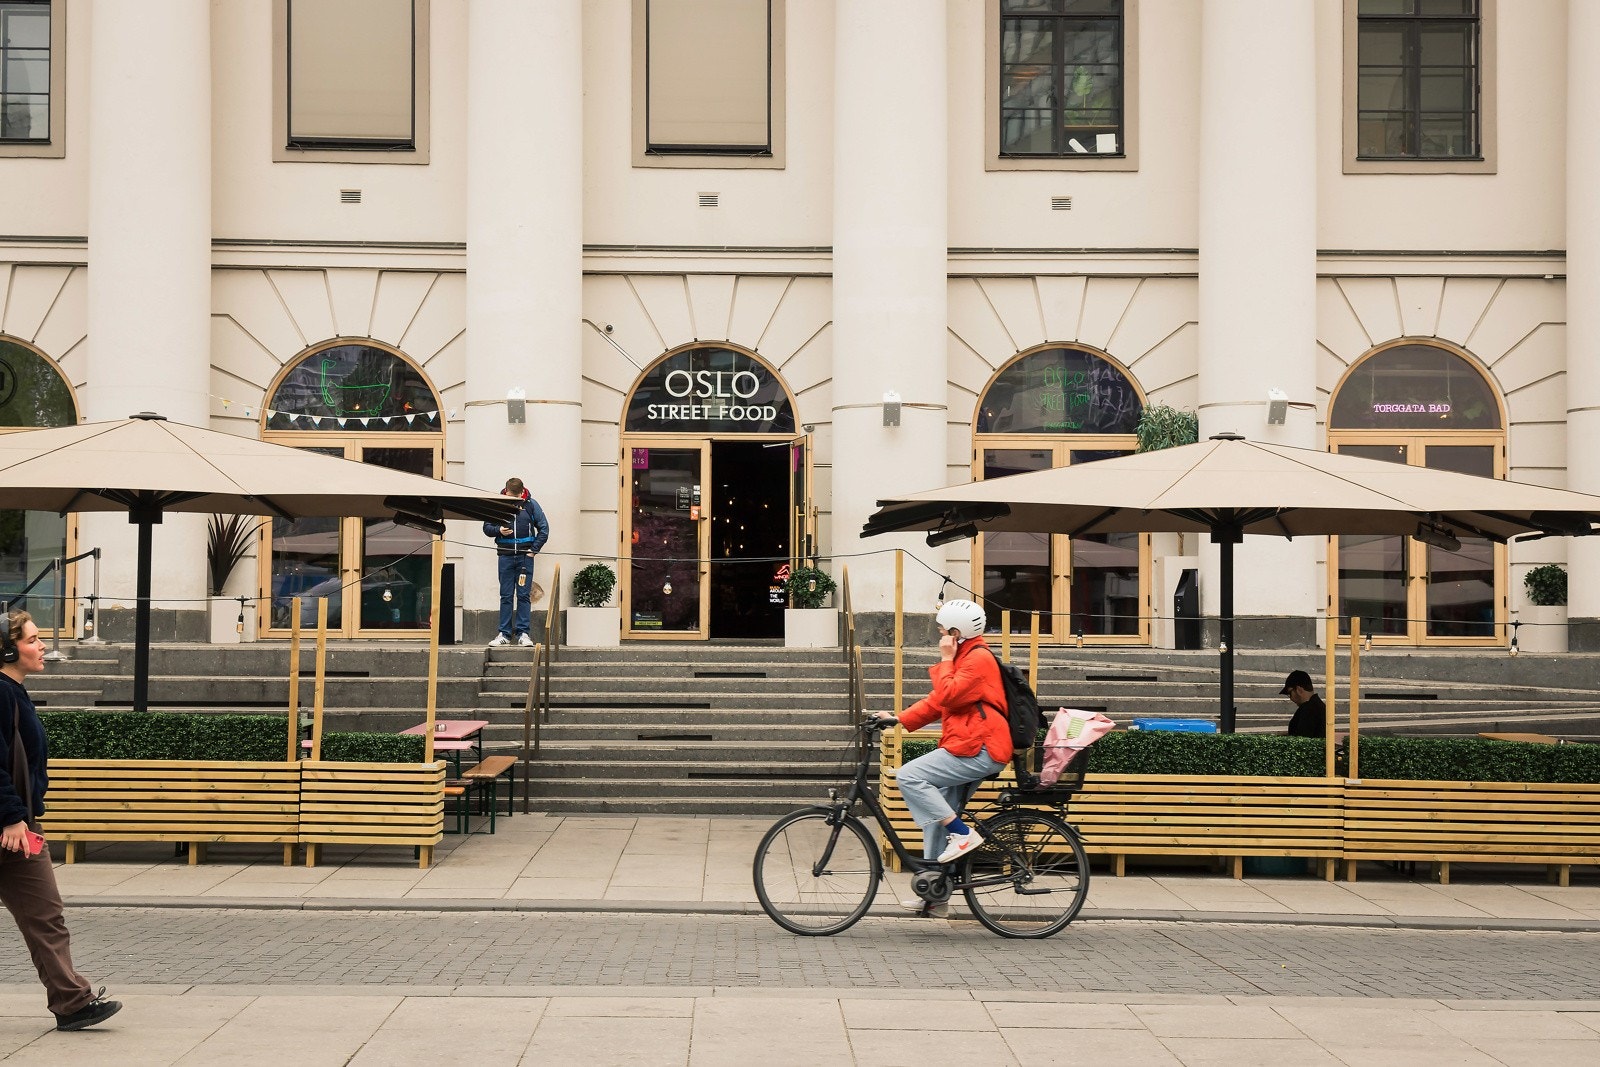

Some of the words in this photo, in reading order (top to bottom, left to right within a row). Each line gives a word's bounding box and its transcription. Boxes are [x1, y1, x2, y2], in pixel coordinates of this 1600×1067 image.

[665, 370, 760, 398] OSLO
[647, 404, 712, 420] STREET
[719, 405, 777, 421] FOOD
[1373, 404, 1426, 412] TORGGATA
[1428, 404, 1450, 412] BAD
